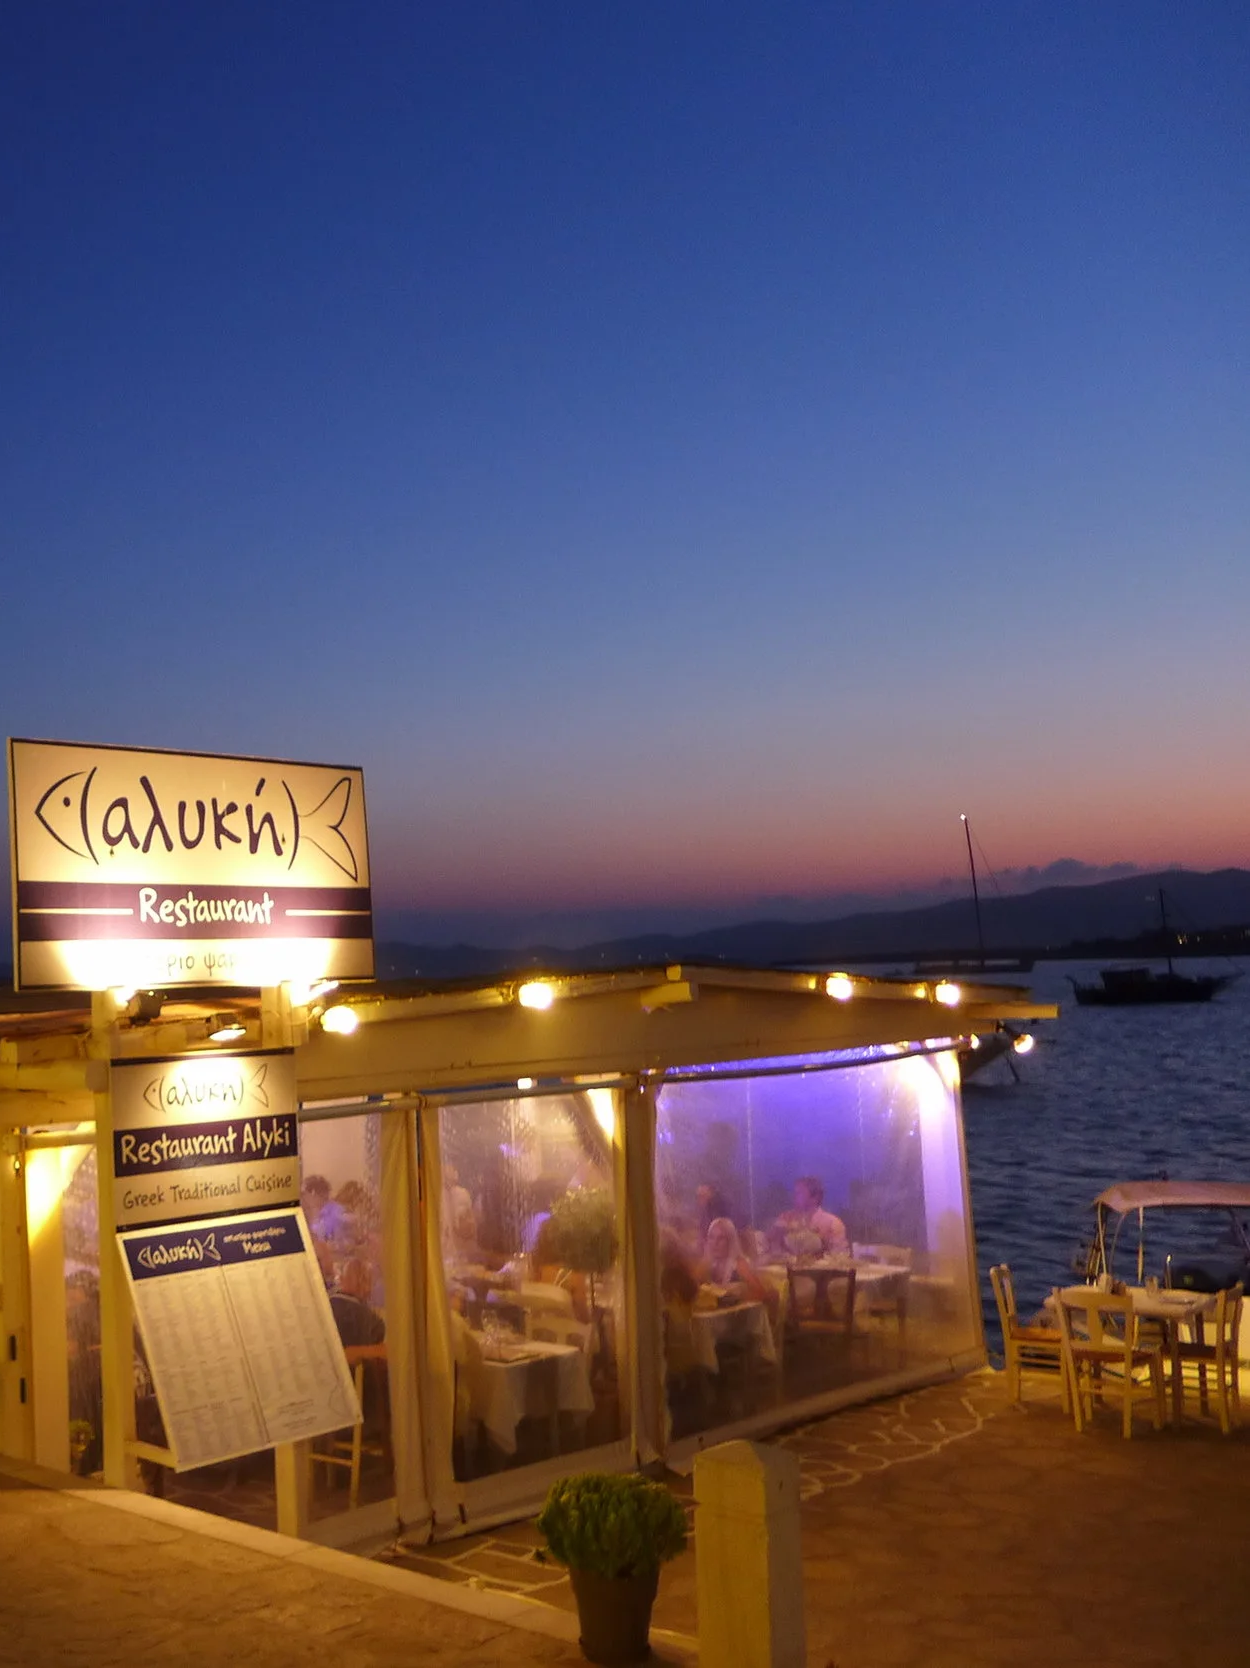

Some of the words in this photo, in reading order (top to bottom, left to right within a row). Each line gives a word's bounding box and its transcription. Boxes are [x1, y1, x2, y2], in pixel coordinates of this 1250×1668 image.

[137, 887, 275, 928] Restaurant
[120, 1125, 238, 1166] Restaurant
[242, 1118, 291, 1158] Alyki
[123, 1186, 165, 1210] Greek
[170, 1176, 241, 1203] Traditional
[245, 1172, 292, 1192] Cuisine
